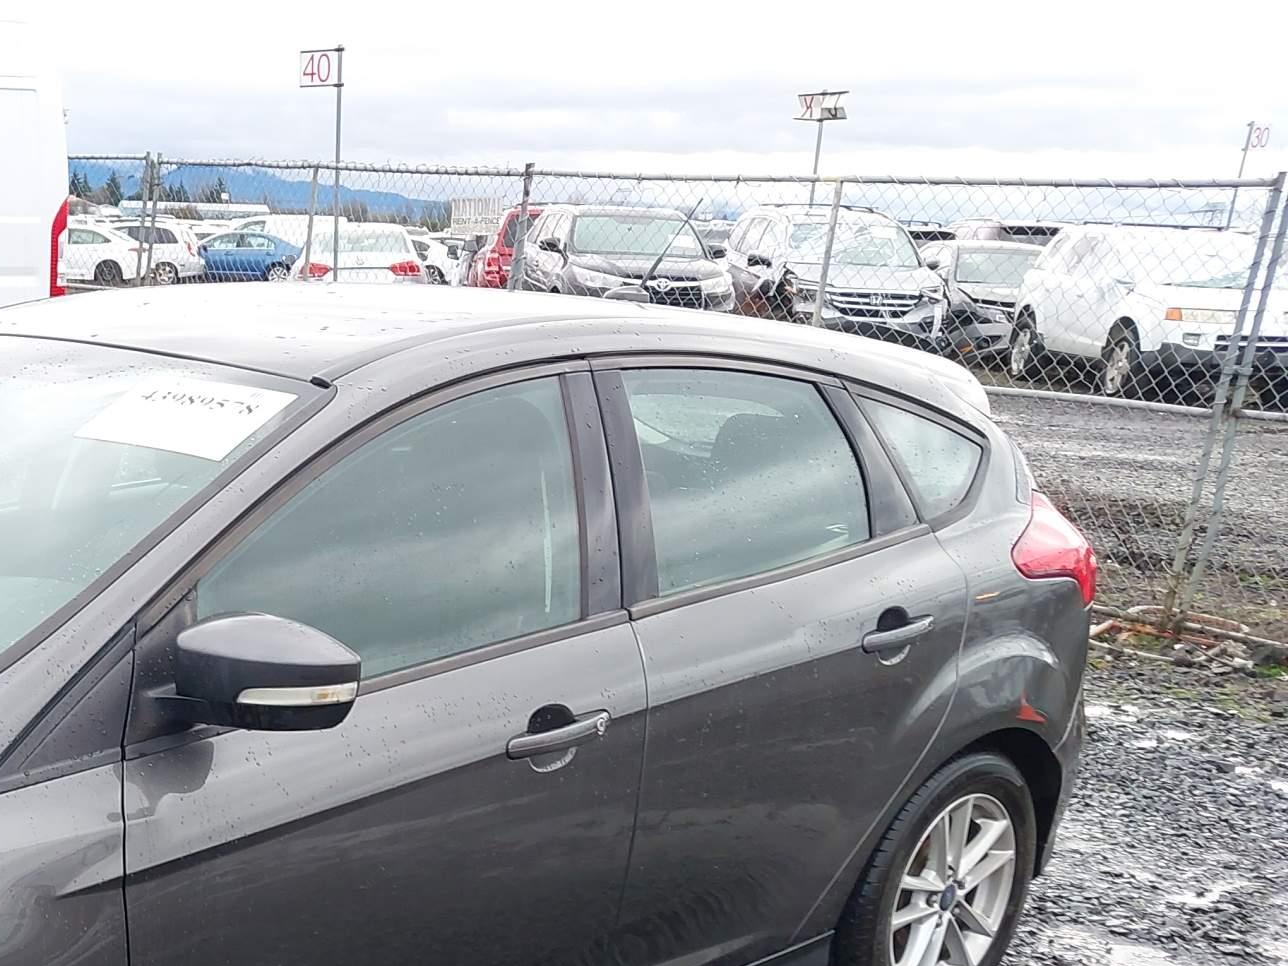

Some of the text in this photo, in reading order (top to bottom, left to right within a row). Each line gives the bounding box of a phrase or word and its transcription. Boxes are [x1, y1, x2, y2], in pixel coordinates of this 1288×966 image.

[303, 53, 331, 83] 40
[1251, 127, 1269, 148] 30
[452, 198, 504, 217] NATIONAL
